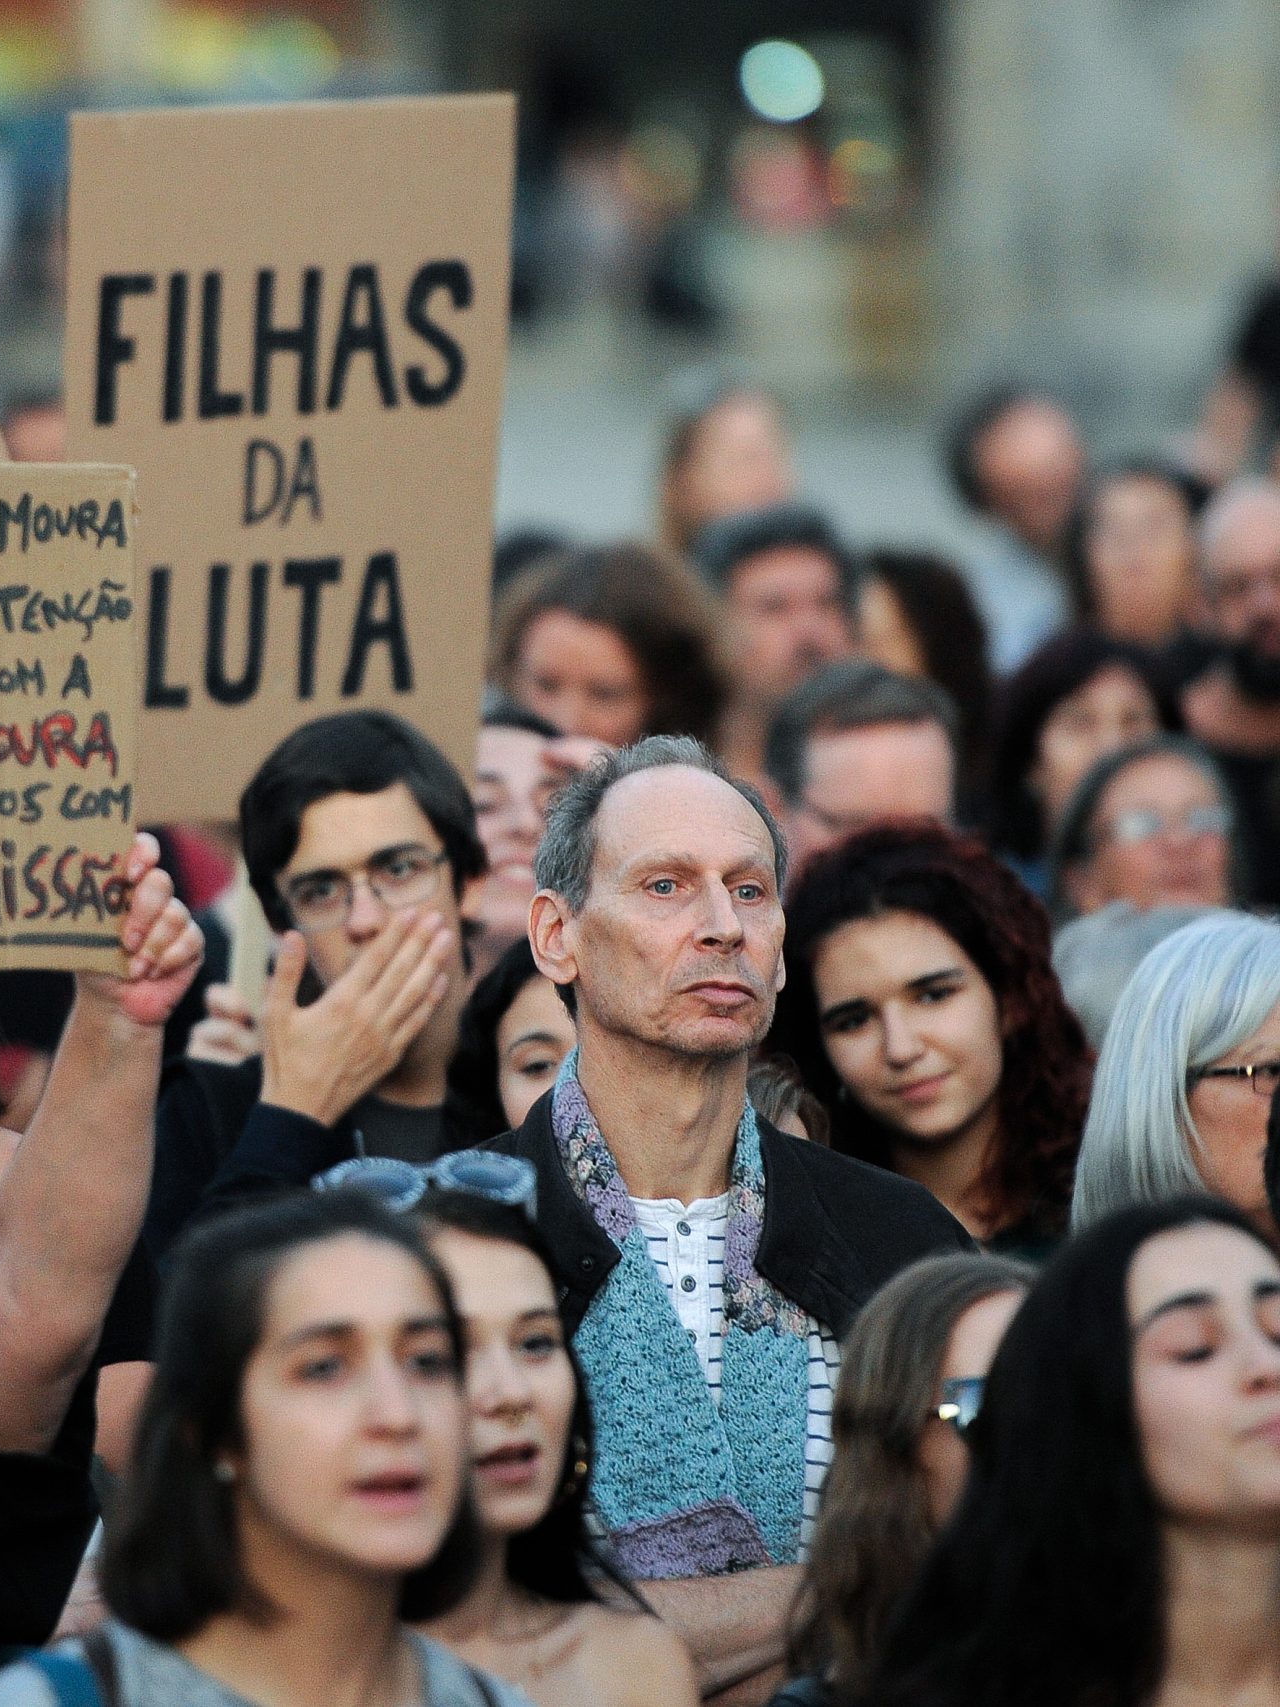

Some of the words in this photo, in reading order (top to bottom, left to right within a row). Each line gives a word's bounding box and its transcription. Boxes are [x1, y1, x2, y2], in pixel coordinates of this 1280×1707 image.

[94, 257, 474, 426] FILHAS
[242, 437, 322, 527] DA
[144, 551, 414, 708] LUTA
[62, 654, 91, 698] A
[60, 784, 132, 823] COM
